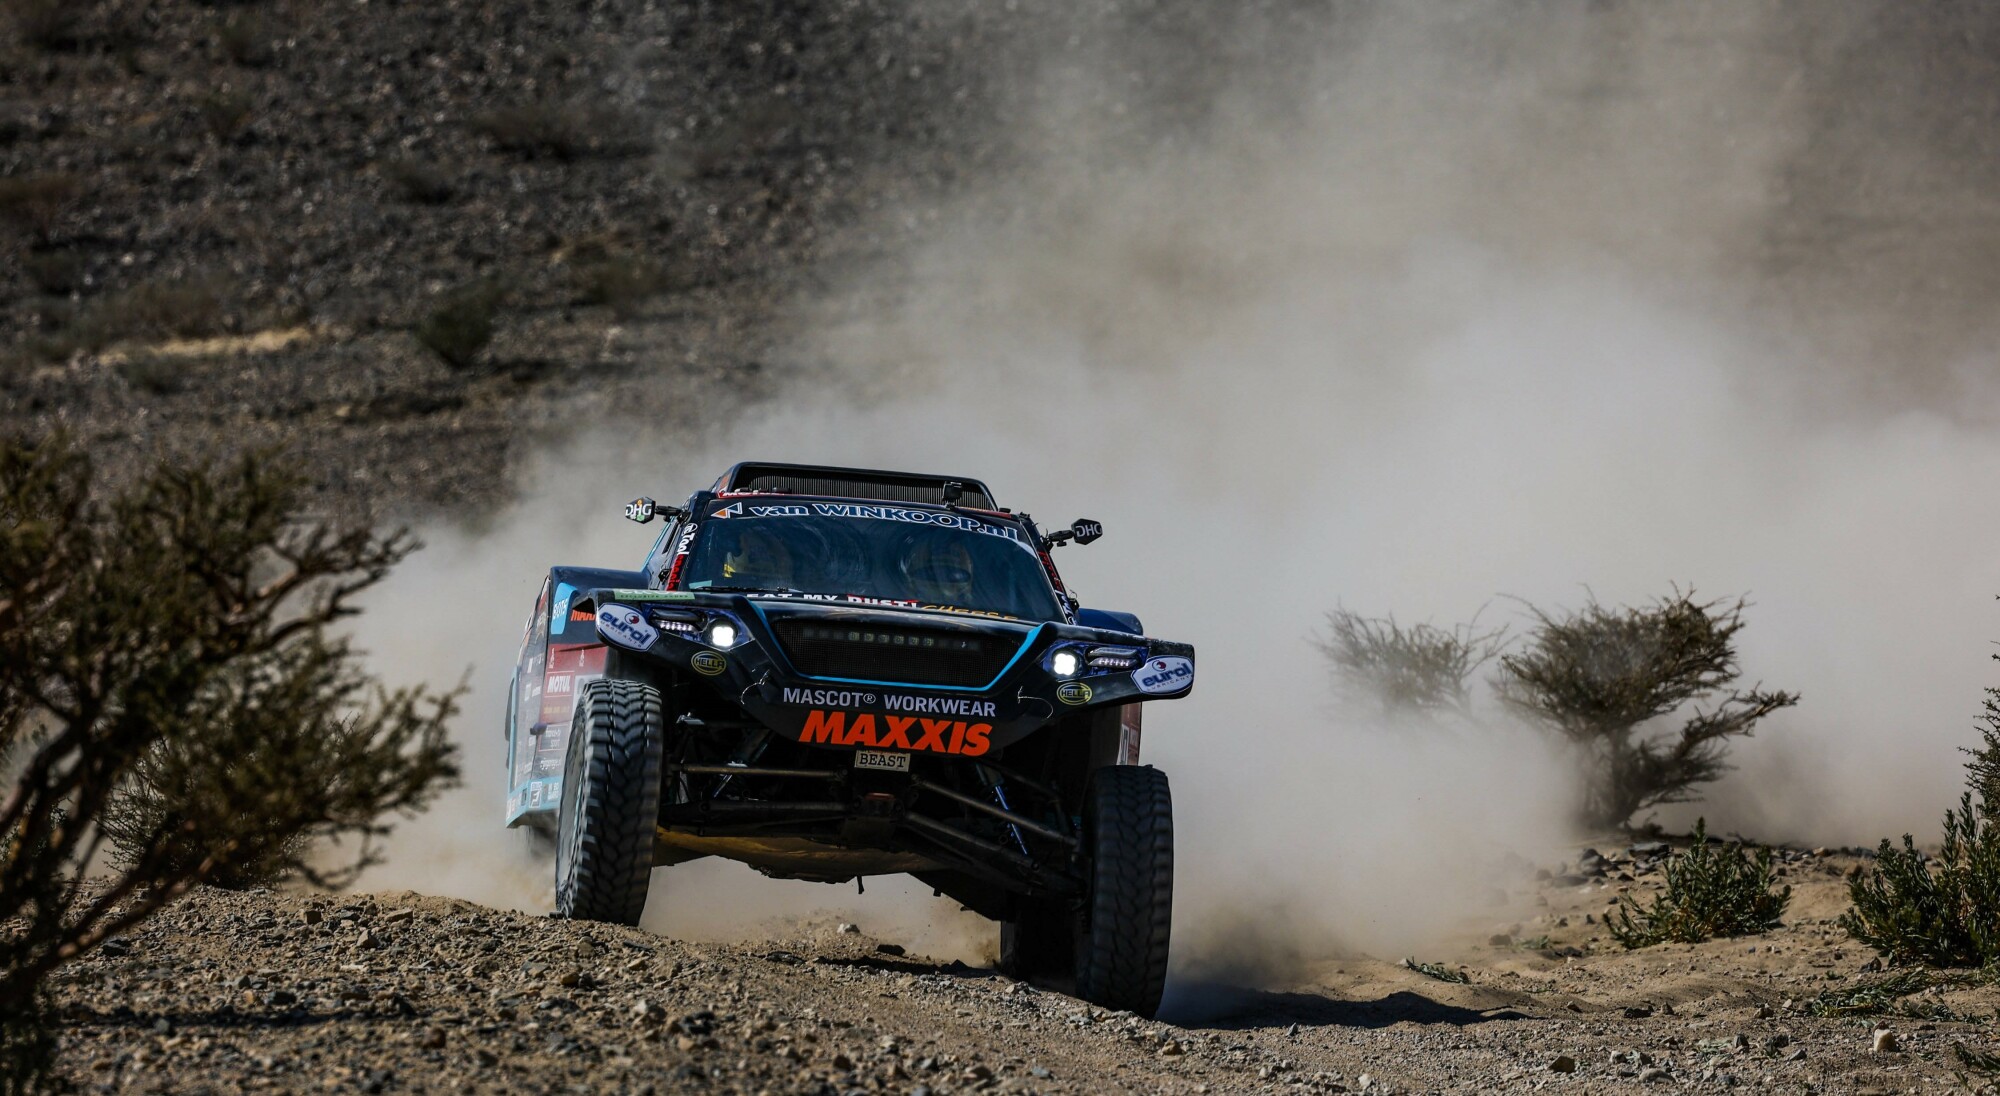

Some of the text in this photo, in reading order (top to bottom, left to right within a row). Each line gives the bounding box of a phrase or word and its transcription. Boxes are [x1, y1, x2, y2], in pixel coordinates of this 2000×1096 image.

[626, 503, 652, 516] DHG
[749, 503, 1018, 541] van WINKOOP.nl
[600, 612, 652, 645] eurol
[695, 659, 725, 669] HELLA
[547, 675, 571, 693] MOTUL
[1142, 662, 1192, 687] eurol
[1061, 688, 1091, 698] HELLA
[884, 694, 996, 717] WORKWEAR
[798, 709, 993, 757] MAXXIS
[859, 753, 906, 768] BEAST
